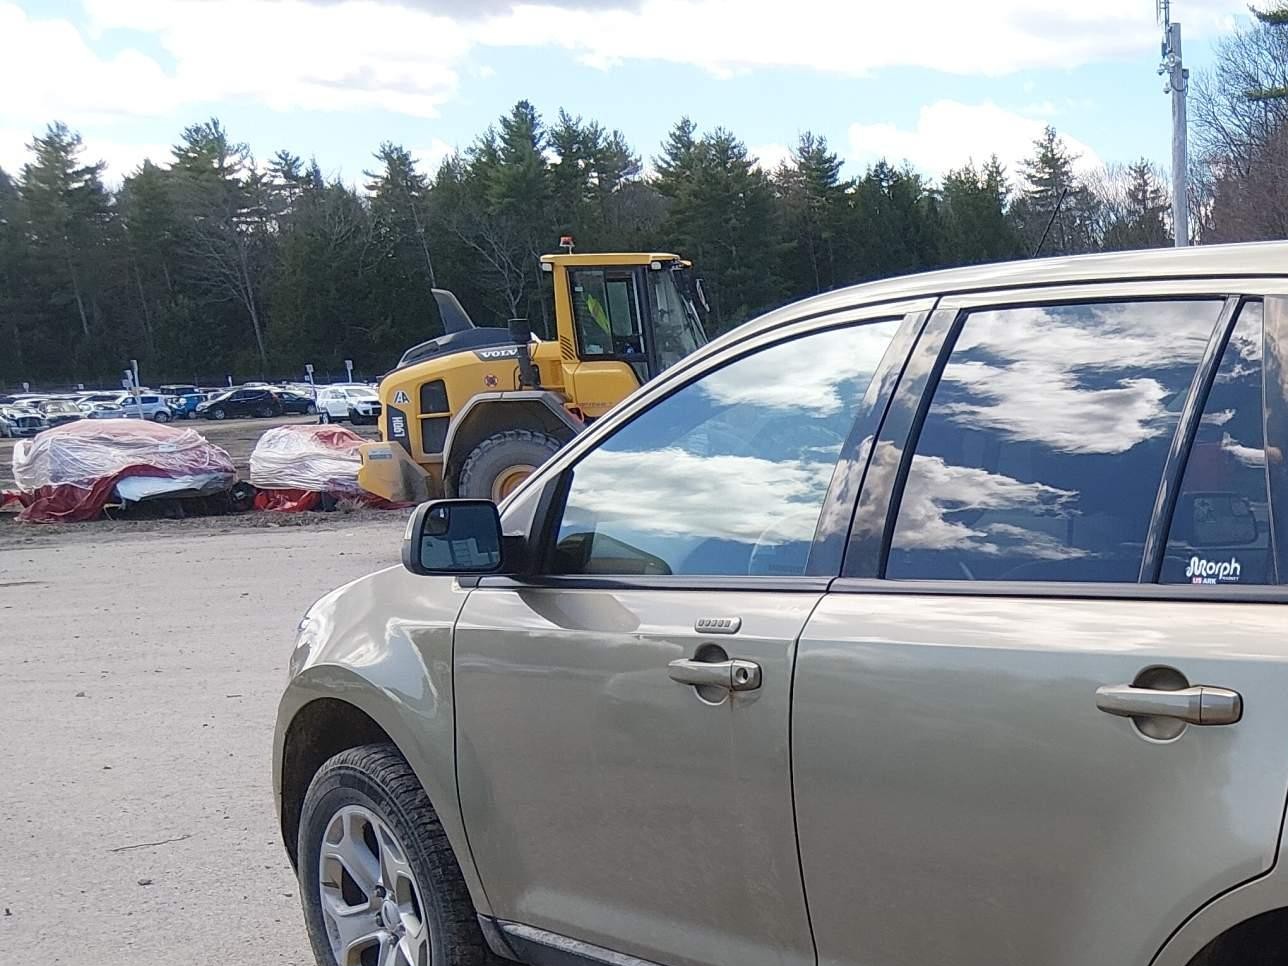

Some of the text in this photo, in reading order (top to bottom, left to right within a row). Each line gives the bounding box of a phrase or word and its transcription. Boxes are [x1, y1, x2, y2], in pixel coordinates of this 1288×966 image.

[480, 349, 518, 359] VOLV
[391, 416, 406, 437] L90H
[1186, 556, 1240, 580] Morph
